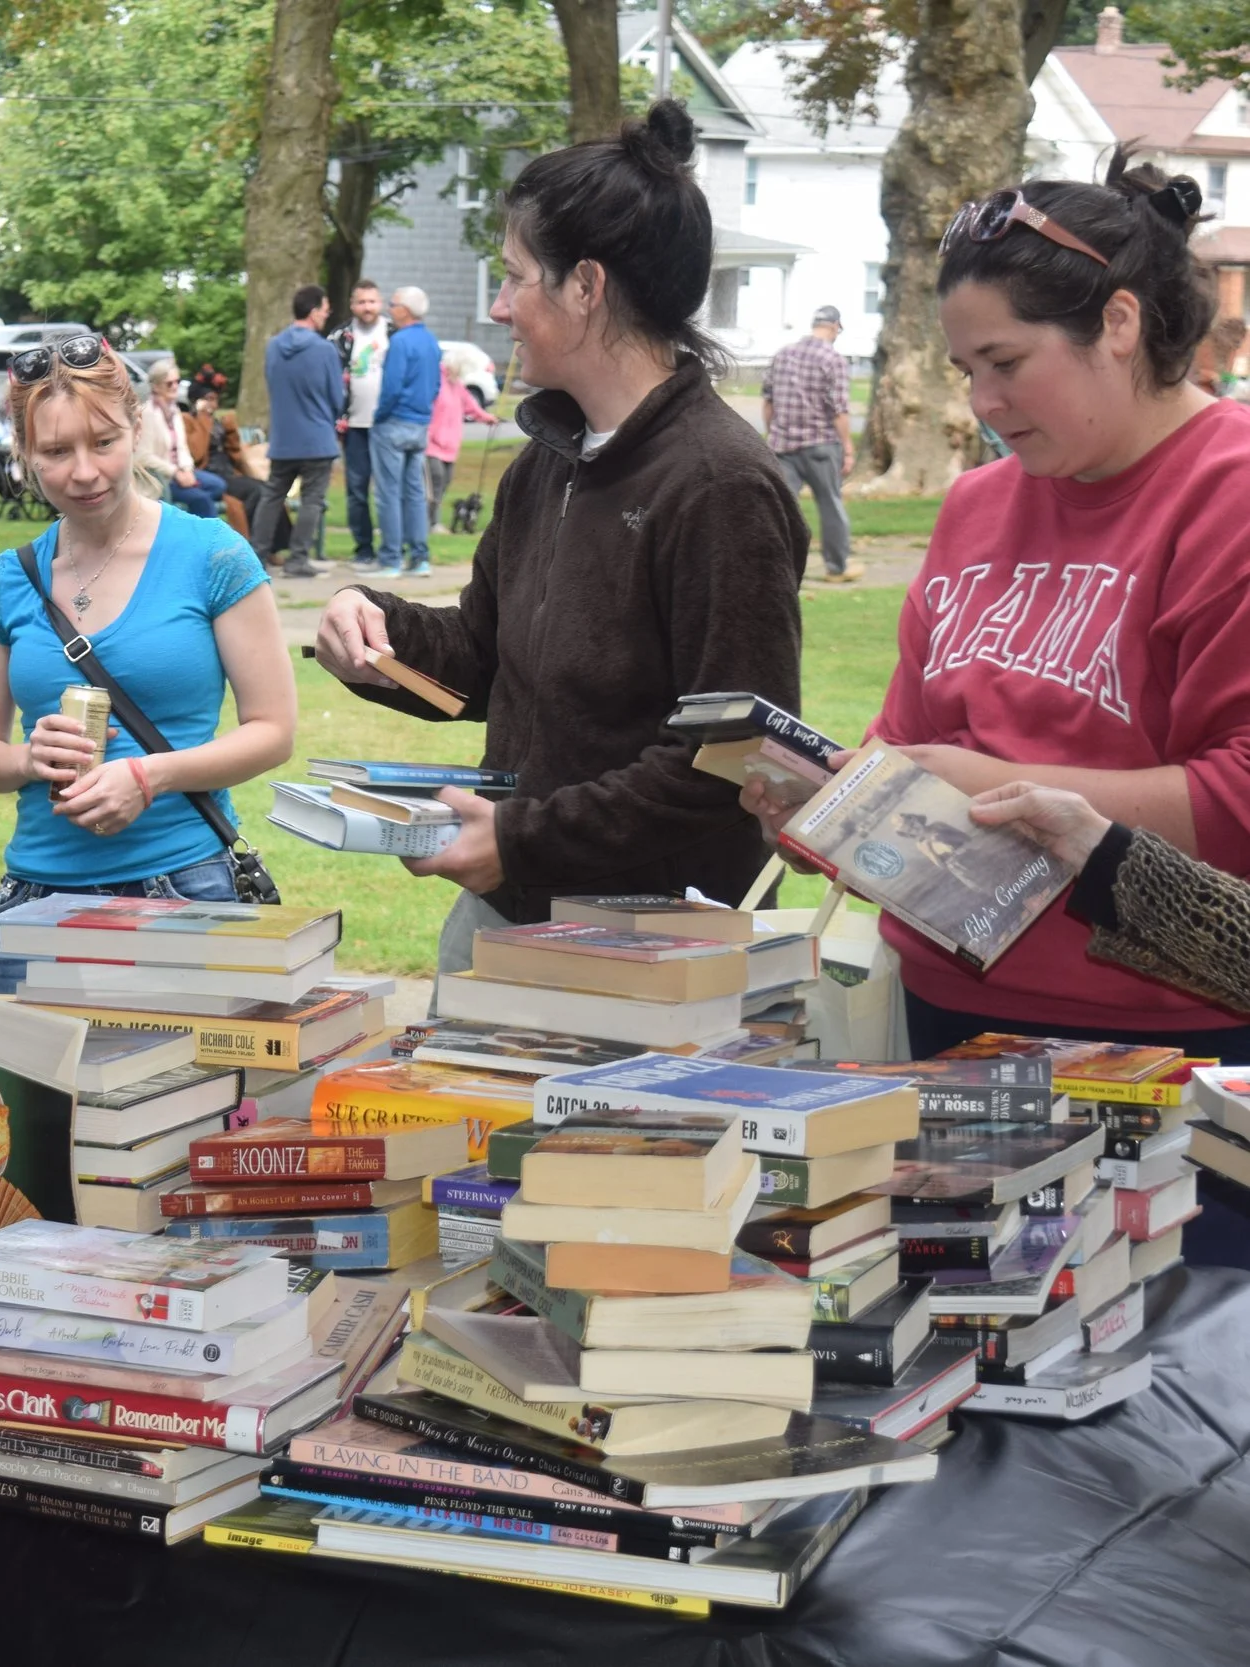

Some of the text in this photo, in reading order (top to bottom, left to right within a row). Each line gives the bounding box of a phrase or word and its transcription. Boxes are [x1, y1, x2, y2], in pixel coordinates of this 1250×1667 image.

[959, 904, 999, 949] Lily's
[995, 854, 1050, 907] Crossing
[200, 1032, 256, 1050] RICHARD COLE
[325, 1102, 359, 1122] SUE
[945, 1100, 986, 1113] ROSES
[1000, 1092, 1011, 1119] DAVIS
[232, 1148, 240, 1175] DEAN
[239, 1147, 307, 1174] KOONTZ
[347, 1147, 365, 1157] THE
[348, 1158, 380, 1170] TAKING
[280, 1195, 296, 1205] LIFE
[446, 1188, 498, 1204] STEERING
[318, 1289, 378, 1358] CARTER CASH
[421, 1350, 486, 1384] grandmother asked me
[421, 1367, 474, 1399] tell you she's sorry
[8, 1389, 59, 1418] Clark
[115, 1405, 201, 1435] Remember
[203, 1416, 227, 1439] Me
[20, 1442, 40, 1455] Saw
[42, 1444, 62, 1458] and
[64, 1446, 86, 1464] How
[95, 1451, 119, 1468] Lied
[364, 1404, 378, 1420] THE
[378, 1408, 405, 1427] DOORS
[417, 1417, 441, 1442] When
[442, 1425, 460, 1443] the
[501, 1446, 528, 1463] Over
[538, 1457, 562, 1475] Chuck
[562, 1464, 600, 1485] Crisafulli
[31, 1463, 51, 1477] Zen
[54, 1469, 93, 1485] Practice
[127, 1482, 161, 1497] Dharma
[313, 1444, 529, 1491] PLAYING IN THE BAND
[299, 1466, 739, 1534] JIMI HENDRIX VISUAL DOCUMENTARY TONY BROWN OMNIBUS PRESS
[552, 1481, 584, 1498] Gans
[26, 1491, 132, 1520] HIS HOLINESS THE DALAI LAMA
[41, 1505, 72, 1520] HOWARD
[424, 1495, 535, 1520] PINK FLOYD THE WALL
[227, 1531, 265, 1547] image
[557, 1528, 573, 1539] Ian
[560, 1580, 633, 1599] JOE CASEY
